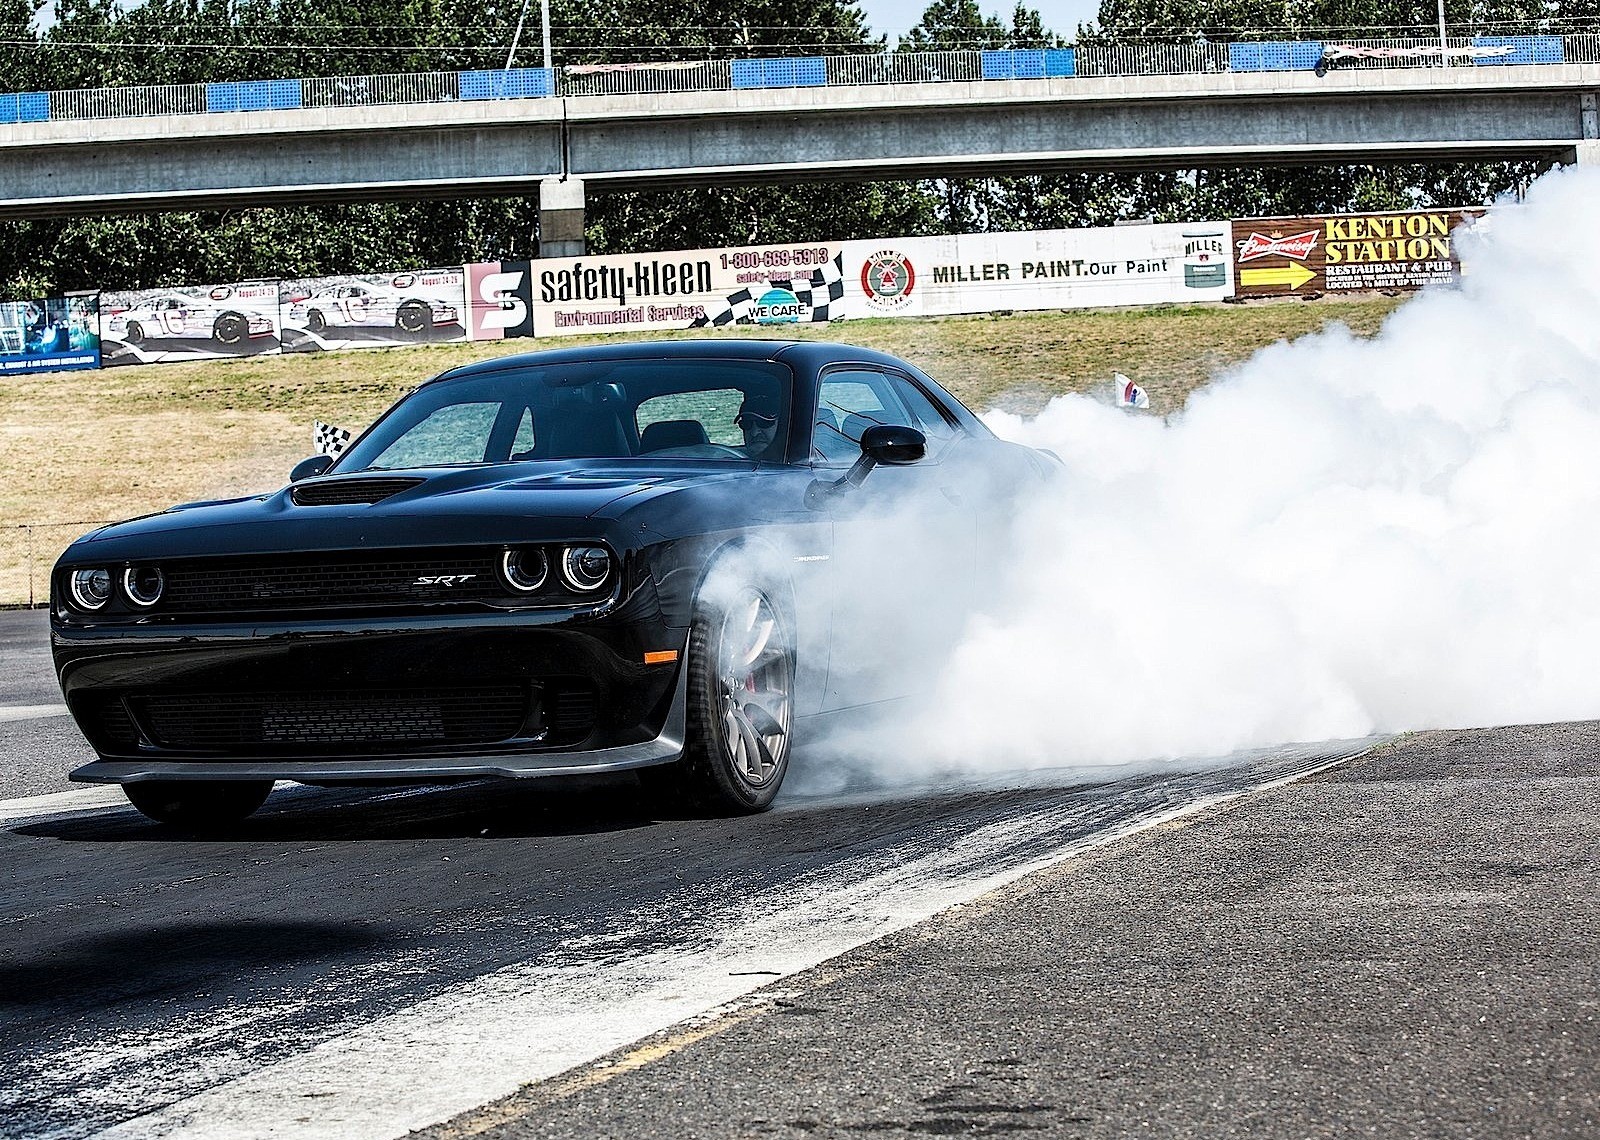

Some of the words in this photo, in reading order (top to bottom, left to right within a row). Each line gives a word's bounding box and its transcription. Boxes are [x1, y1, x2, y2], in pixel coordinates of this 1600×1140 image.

[1324, 214, 1449, 241] KENTON
[720, 248, 829, 269] 1-800-669-5913
[1325, 237, 1451, 264] STATION
[933, 264, 1010, 283] MILLER
[1090, 262, 1117, 275] Our
[1126, 260, 1168, 273] Paint
[1325, 263, 1408, 275] RESTAURANT
[1411, 262, 1422, 273] &
[1425, 261, 1453, 272] PUB
[422, 277, 441, 286] August
[541, 261, 712, 306] safety-kleen
[1325, 281, 1363, 289] LOCATED
[1374, 279, 1395, 287] MILE
[239, 290, 257, 298] August
[337, 298, 367, 322] 16
[555, 306, 644, 327] Environmental
[647, 304, 704, 322] Services
[748, 306, 768, 317] WE
[771, 304, 808, 316] CARE.
[155, 310, 185, 334] 16
[413, 575, 476, 586] SRT
